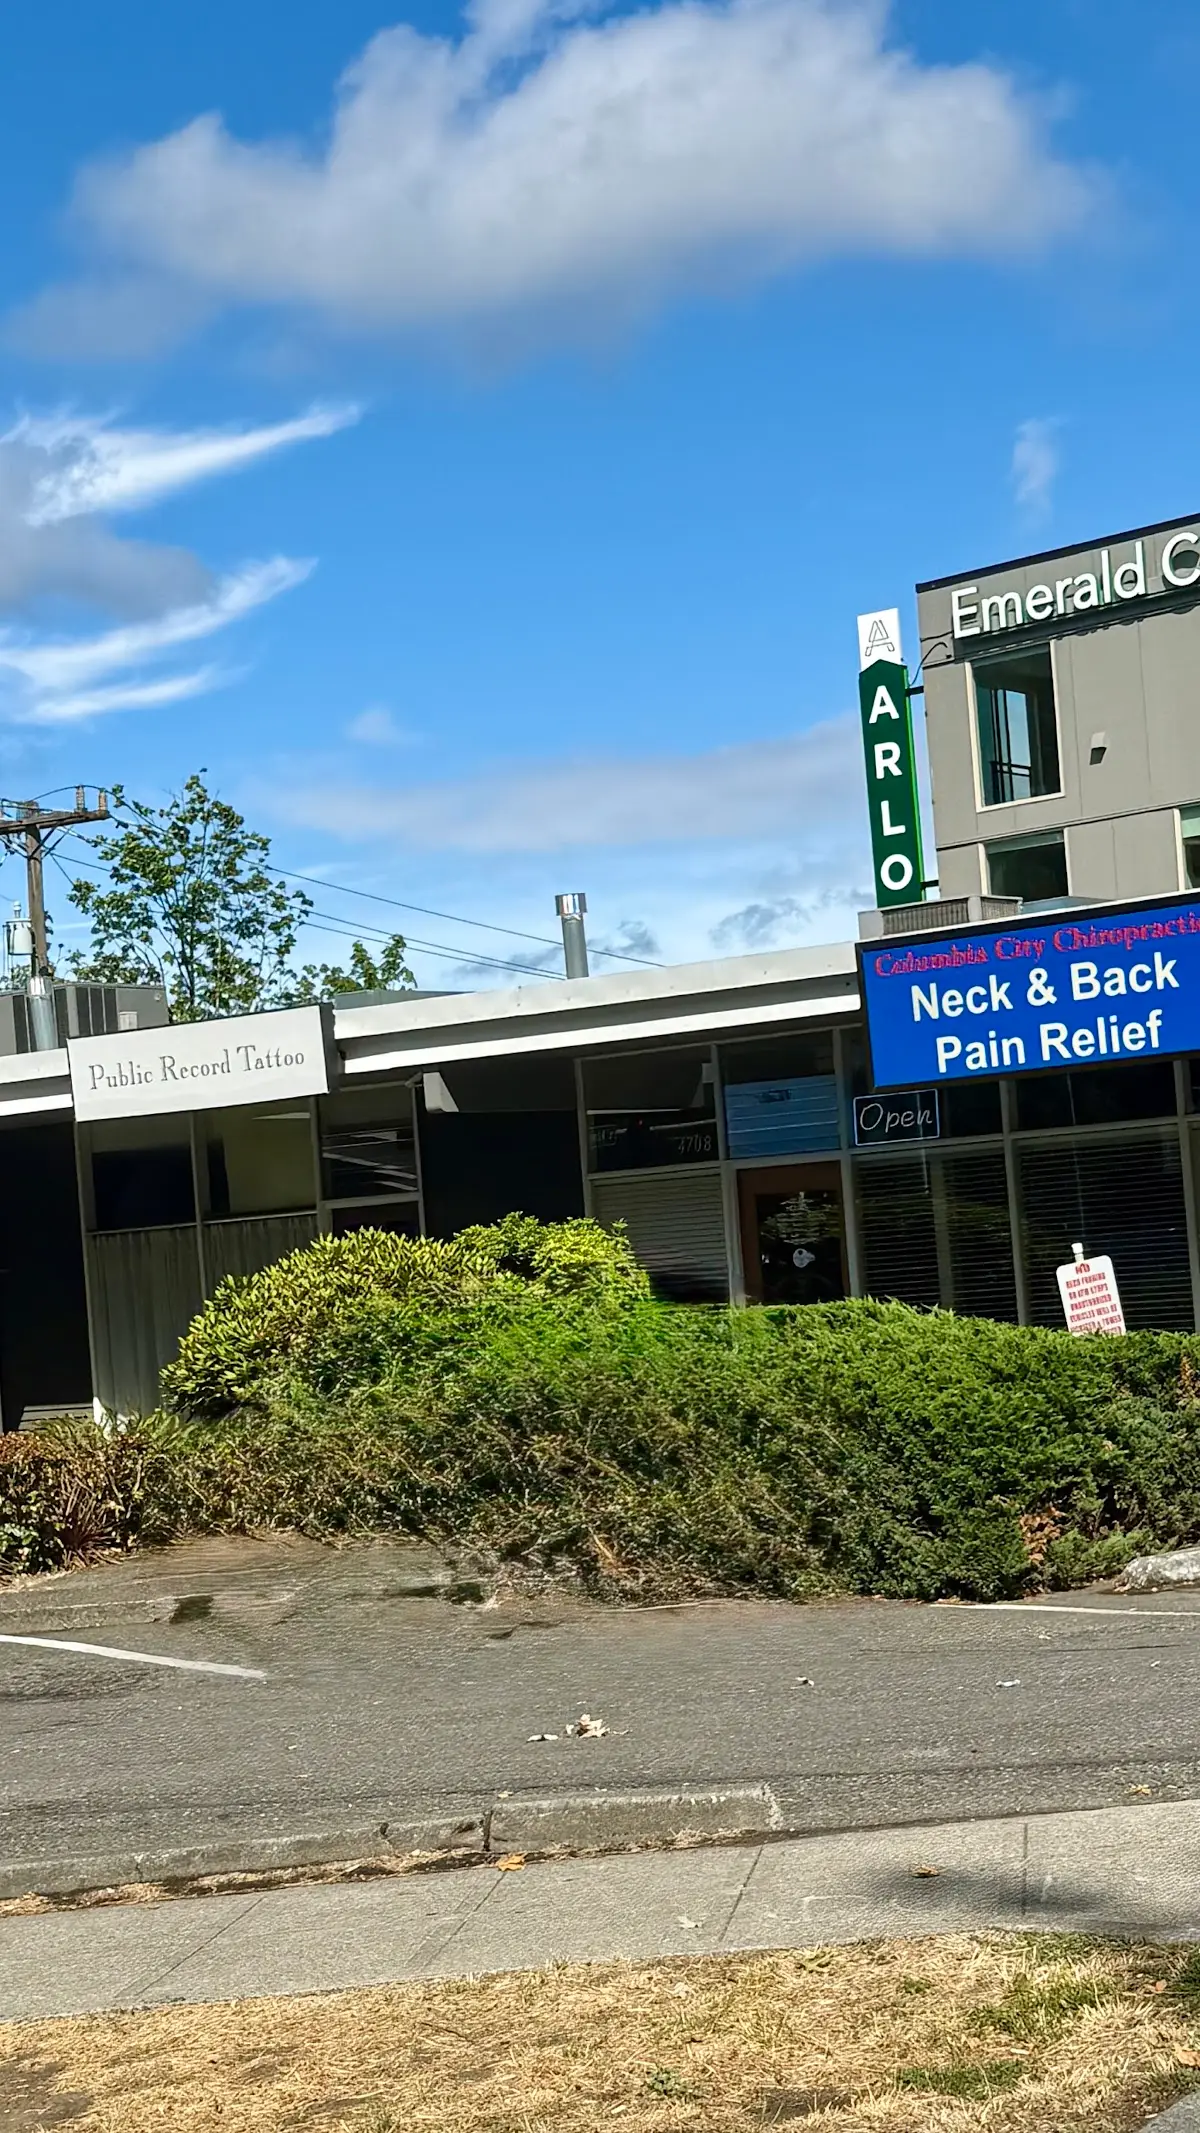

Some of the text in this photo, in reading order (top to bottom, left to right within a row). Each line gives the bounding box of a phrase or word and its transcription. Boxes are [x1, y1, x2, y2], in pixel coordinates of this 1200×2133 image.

[950, 540, 1146, 639] Emerald
[868, 684, 913, 891] ARLO
[911, 951, 1180, 1022] Neck & Back
[88, 1044, 305, 1090] Public Record Tattoo
[935, 1009, 1163, 1073] Pain Relief
[859, 1103, 934, 1133] Open
